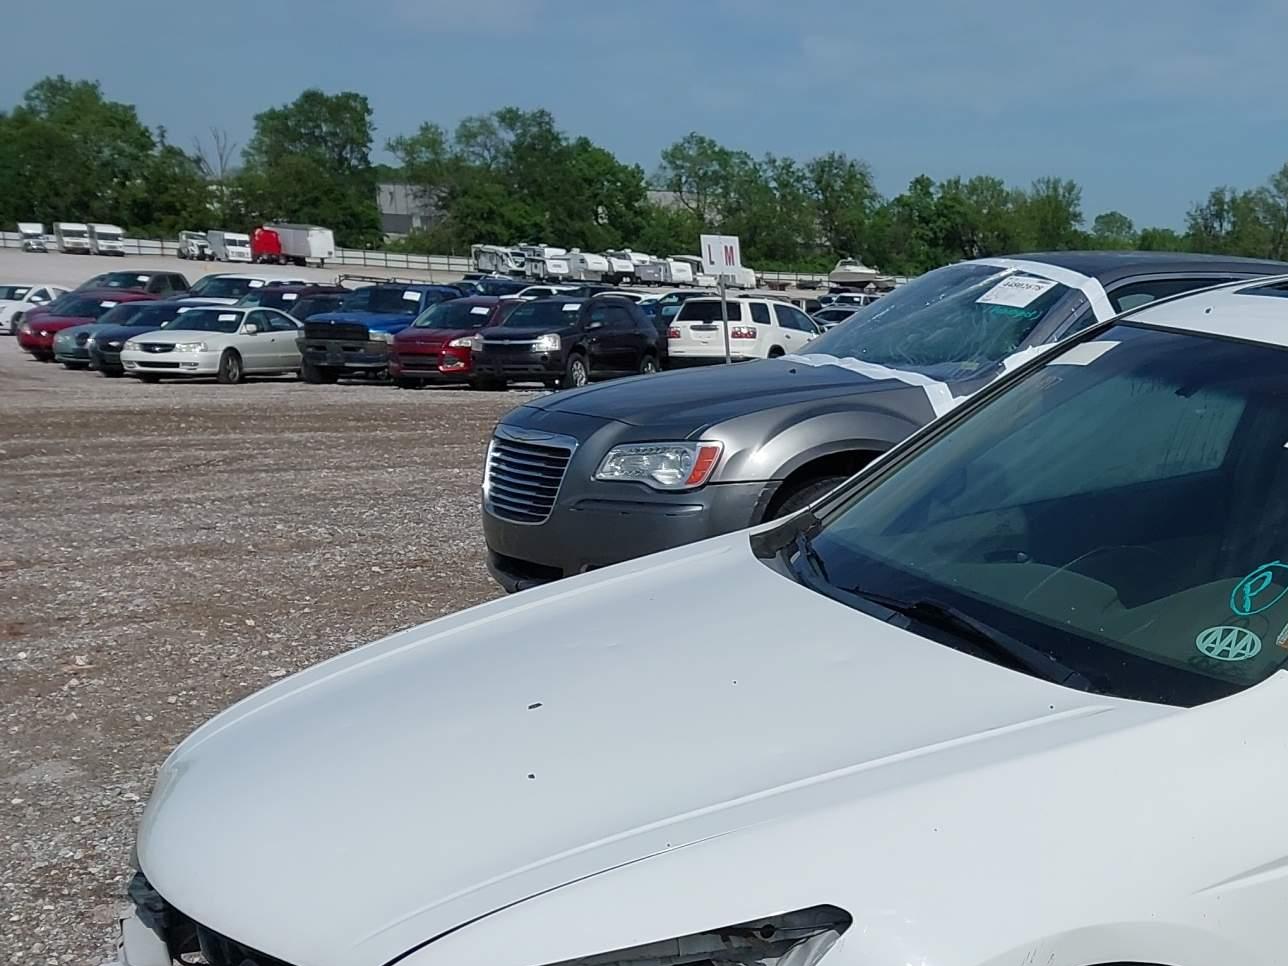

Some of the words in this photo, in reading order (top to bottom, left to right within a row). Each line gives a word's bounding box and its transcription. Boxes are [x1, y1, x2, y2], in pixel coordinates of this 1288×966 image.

[707, 244, 715, 265] L
[724, 244, 735, 266] M
[1243, 571, 1273, 612] P
[1200, 627, 1257, 660] AAA
